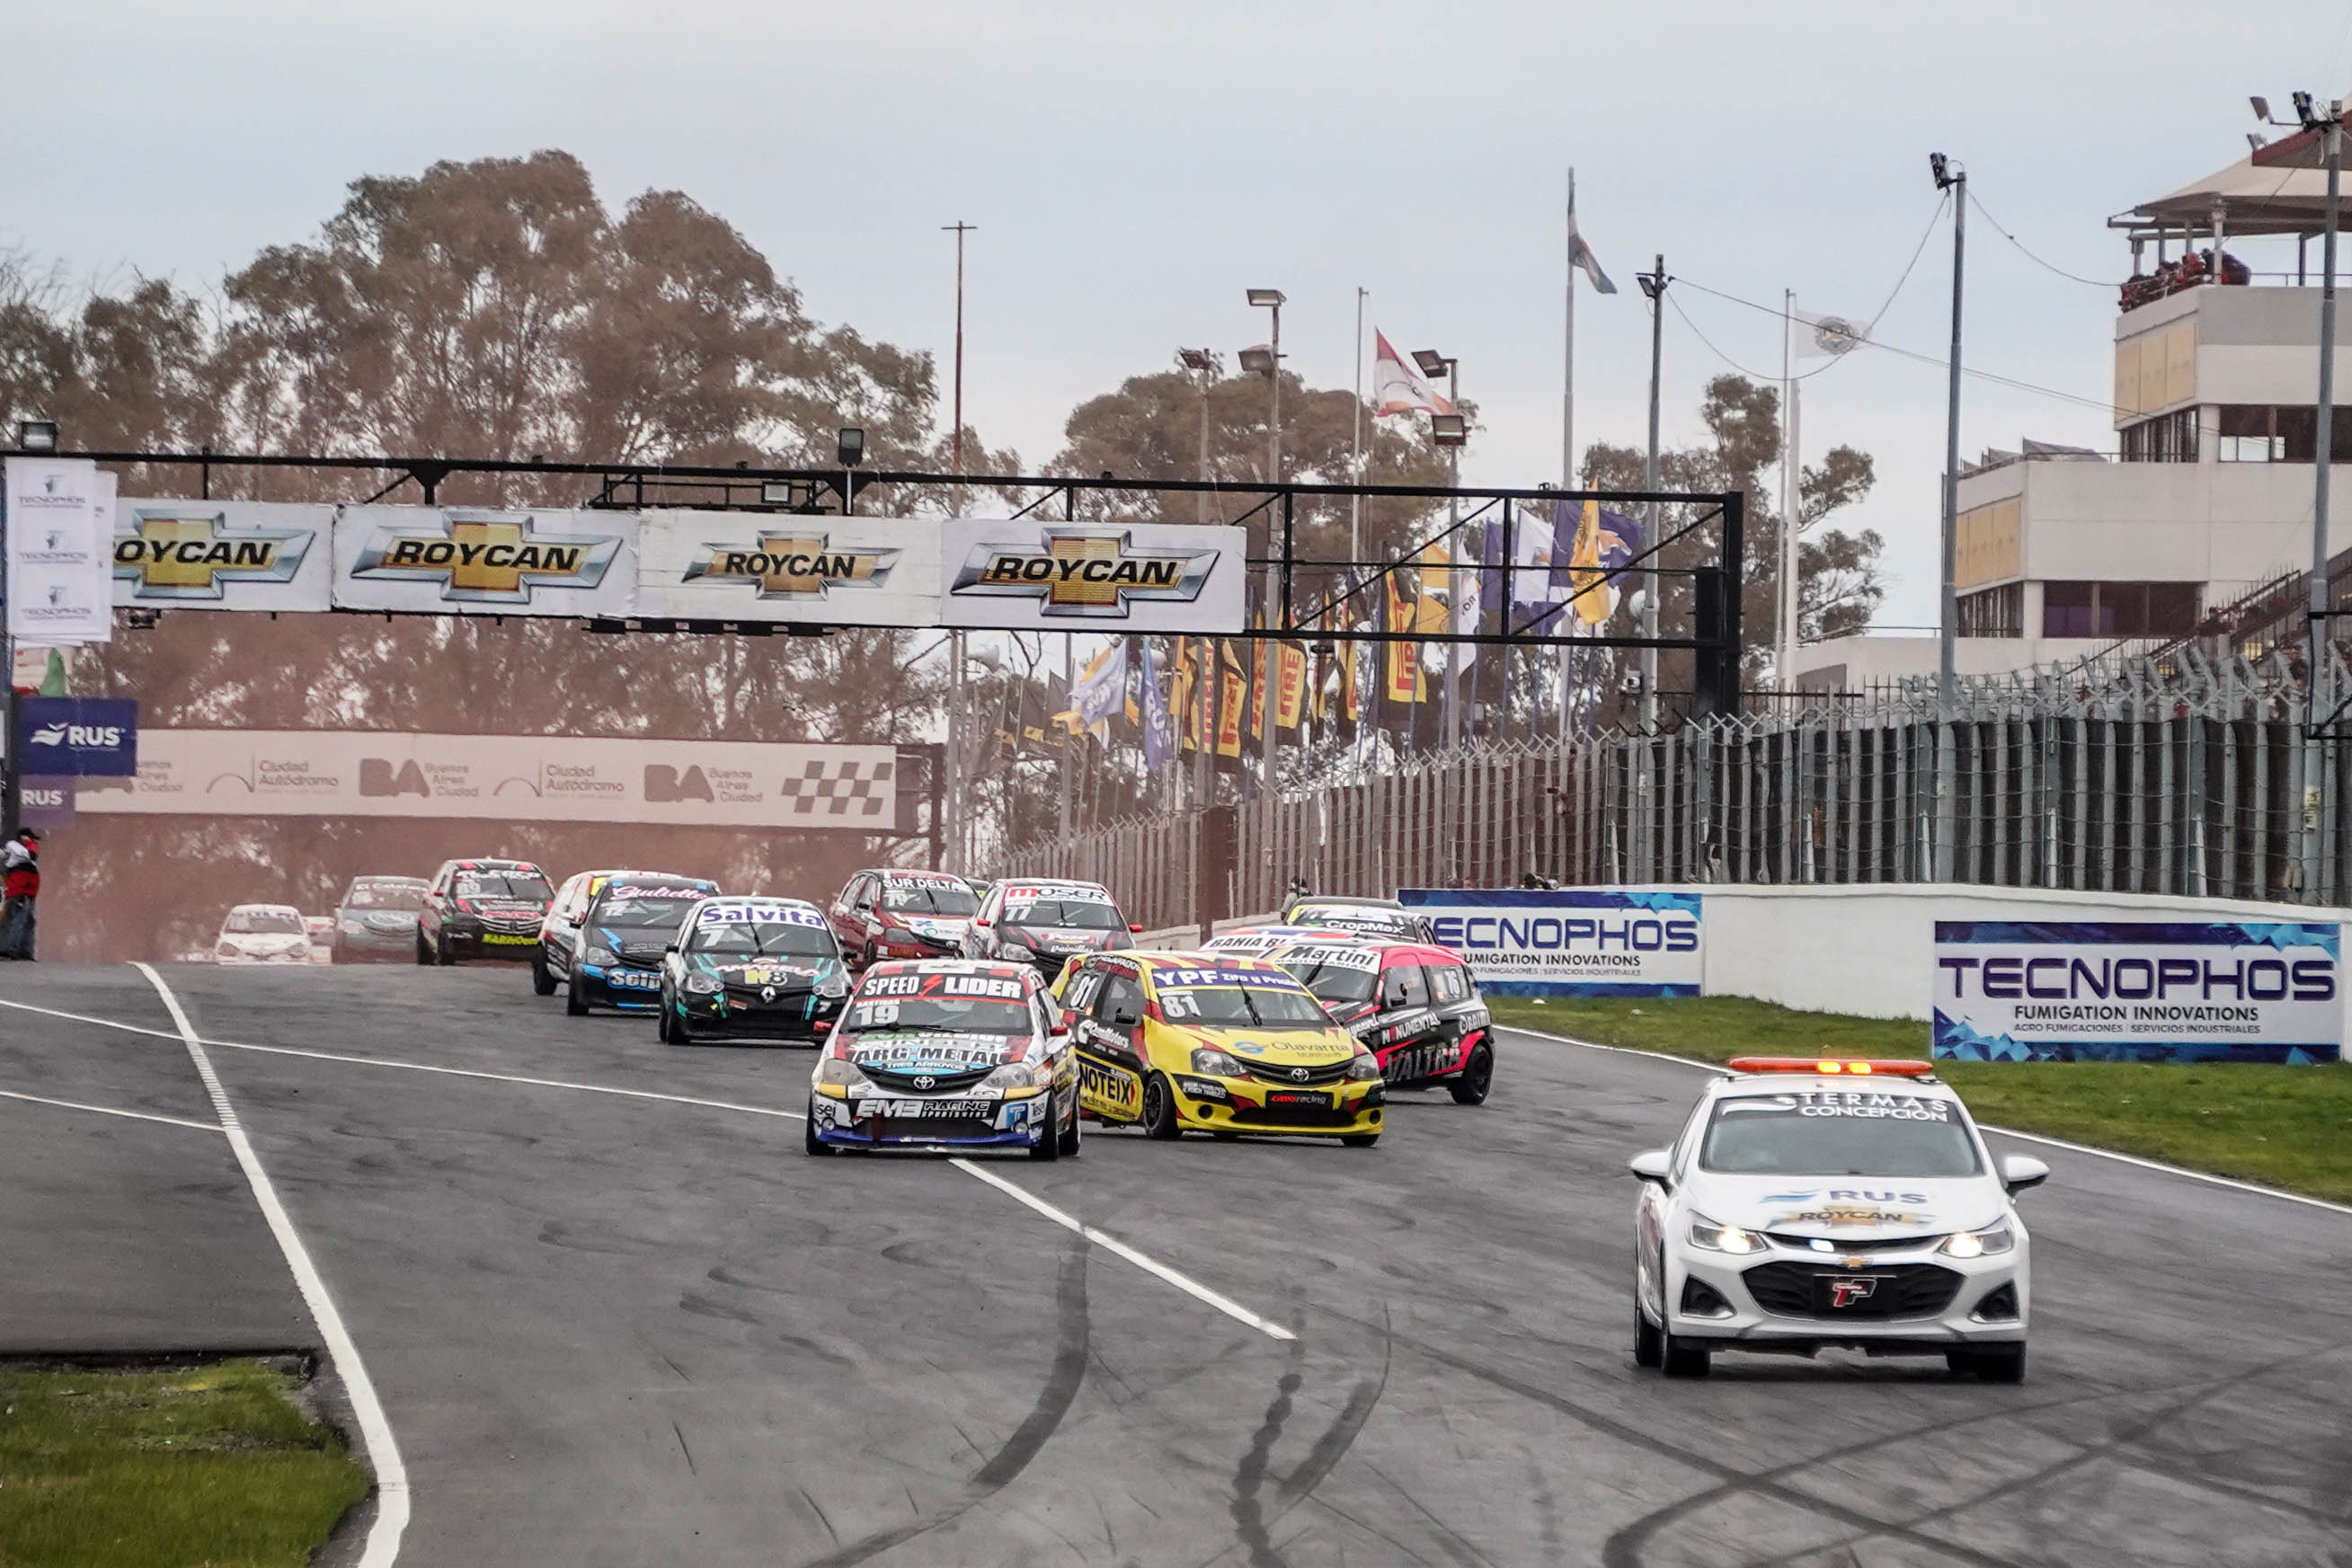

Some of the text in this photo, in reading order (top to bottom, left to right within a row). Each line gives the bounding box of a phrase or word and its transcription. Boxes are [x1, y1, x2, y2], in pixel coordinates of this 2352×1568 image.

[114, 538, 271, 566] OYCAN
[393, 540, 580, 571] ROYCAN
[725, 554, 856, 578] ROYCAN
[991, 557, 1177, 584] ROYCAN
[67, 725, 120, 746] RUS
[259, 760, 308, 772] Ciudad
[546, 765, 595, 776] Ciudad
[708, 767, 753, 779] Buenos
[435, 786, 478, 797] Ciudad
[716, 780, 749, 791] Aires
[21, 789, 64, 806] RUS
[719, 792, 763, 802] Ciudad
[883, 878, 915, 889] SUR
[703, 907, 823, 927] Salvita
[1326, 919, 1406, 935] CropMax
[1280, 945, 1379, 967] Martini
[1546, 953, 1640, 967] INNOVATIONS
[1153, 970, 1219, 986] YPF
[1939, 957, 2336, 1001] TECNOPHOS
[865, 976, 1022, 998] SPEED LIDER
[856, 1005, 899, 1025] 19
[1161, 996, 1202, 1018] 81
[2015, 1005, 2259, 1021] FUMIGATION INNOVATIONS
[2014, 1023, 2261, 1034] AGRO FUMIGACIONES SERVICIOS INDUSTRIALES
[919, 1047, 1007, 1066] METAL
[924, 1101, 991, 1111] RACING
[1799, 1093, 1948, 1112] TERMAS
[1828, 1190, 1929, 1205] RUS
[1798, 1210, 1904, 1222] ROYCAN
